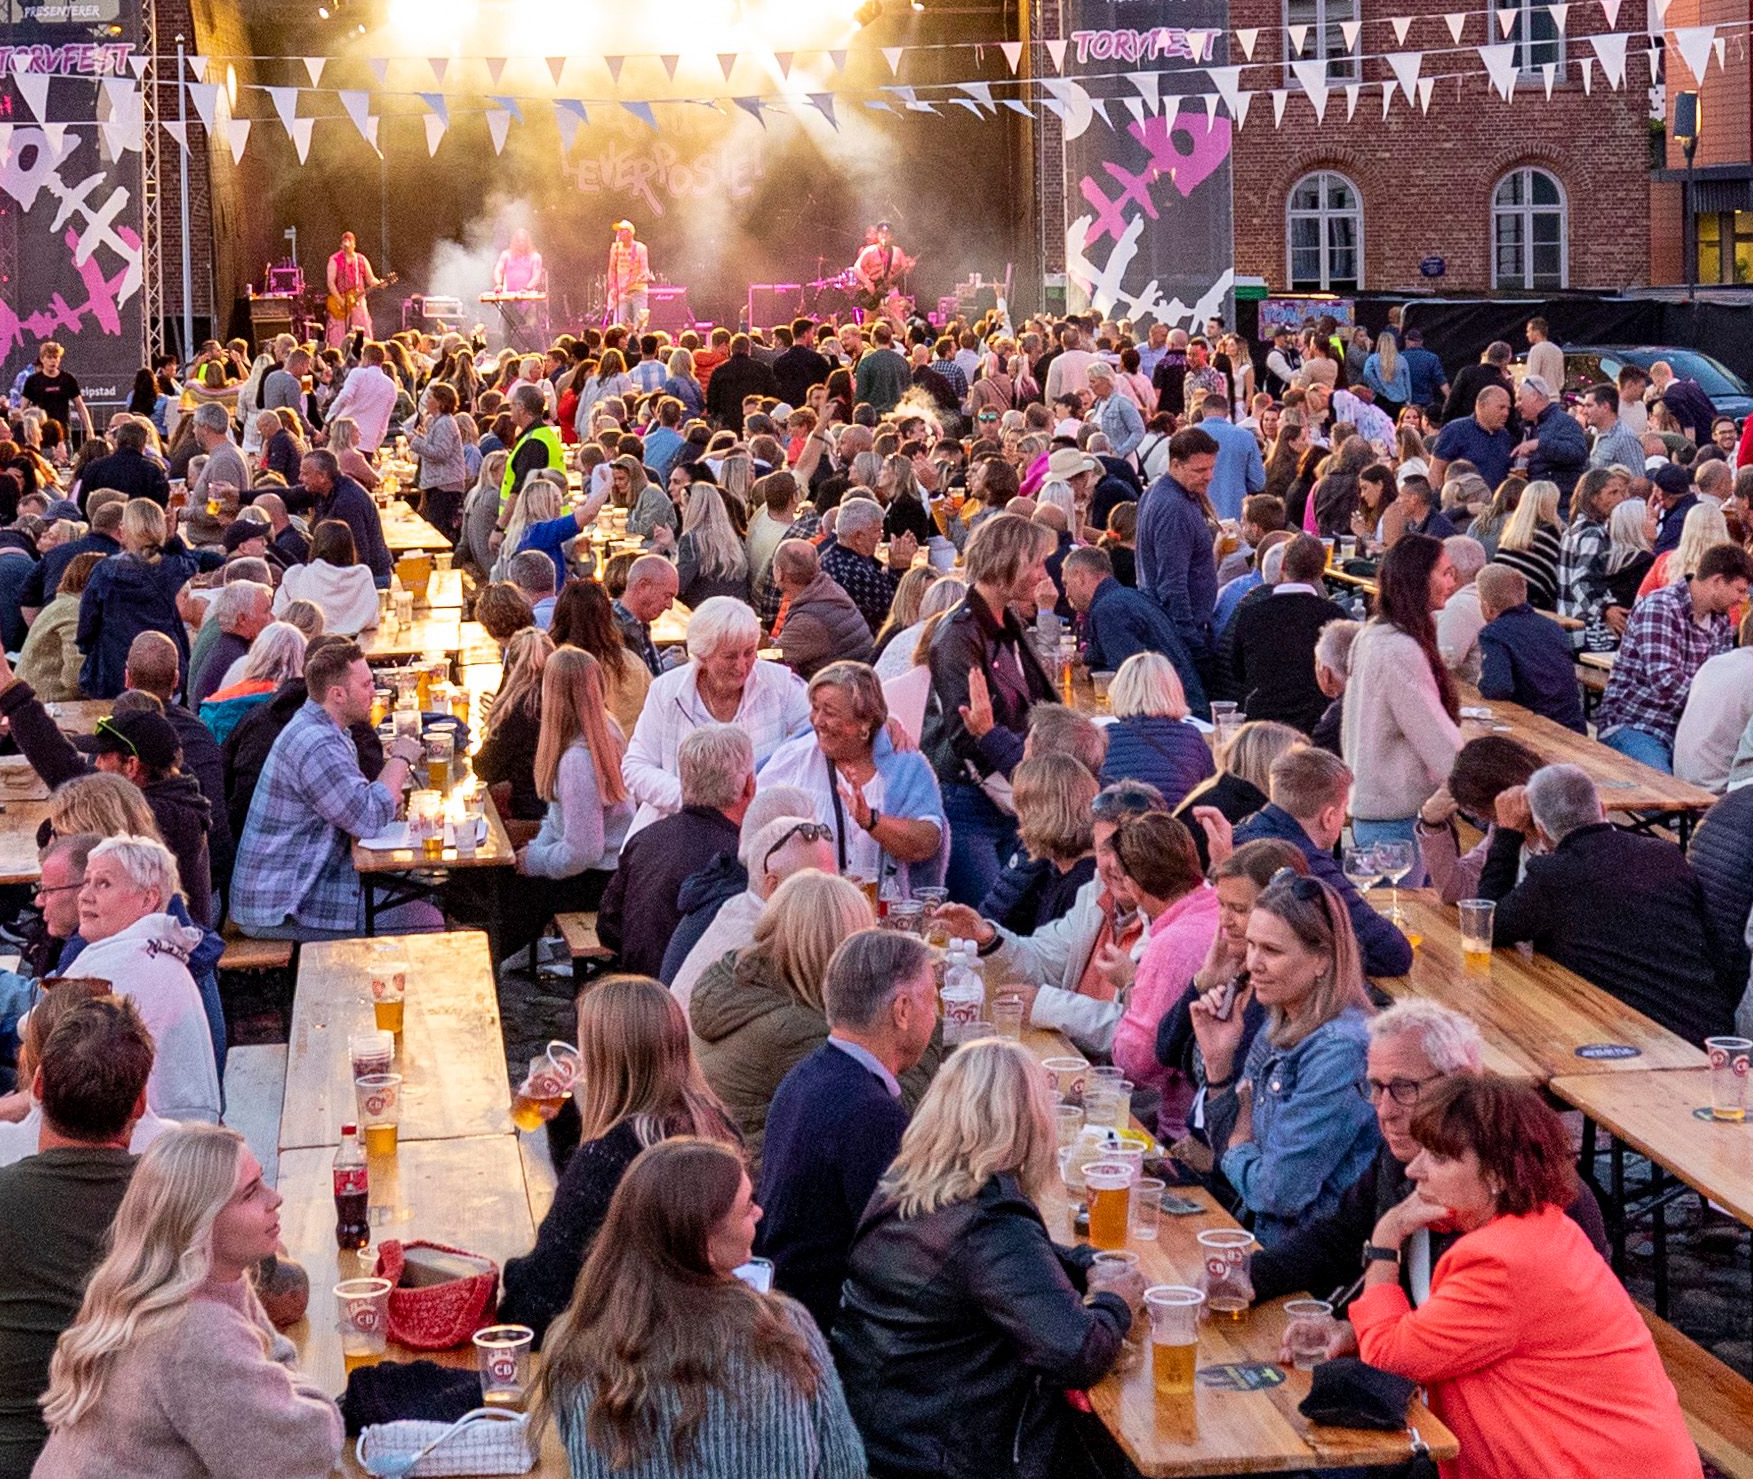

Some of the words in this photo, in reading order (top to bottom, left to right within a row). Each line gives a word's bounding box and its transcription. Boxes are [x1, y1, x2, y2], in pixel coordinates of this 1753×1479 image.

[25, 5, 100, 18] PRESENTERER
[80, 386, 116, 398] eipstad
[494, 1363, 513, 1376] CB
